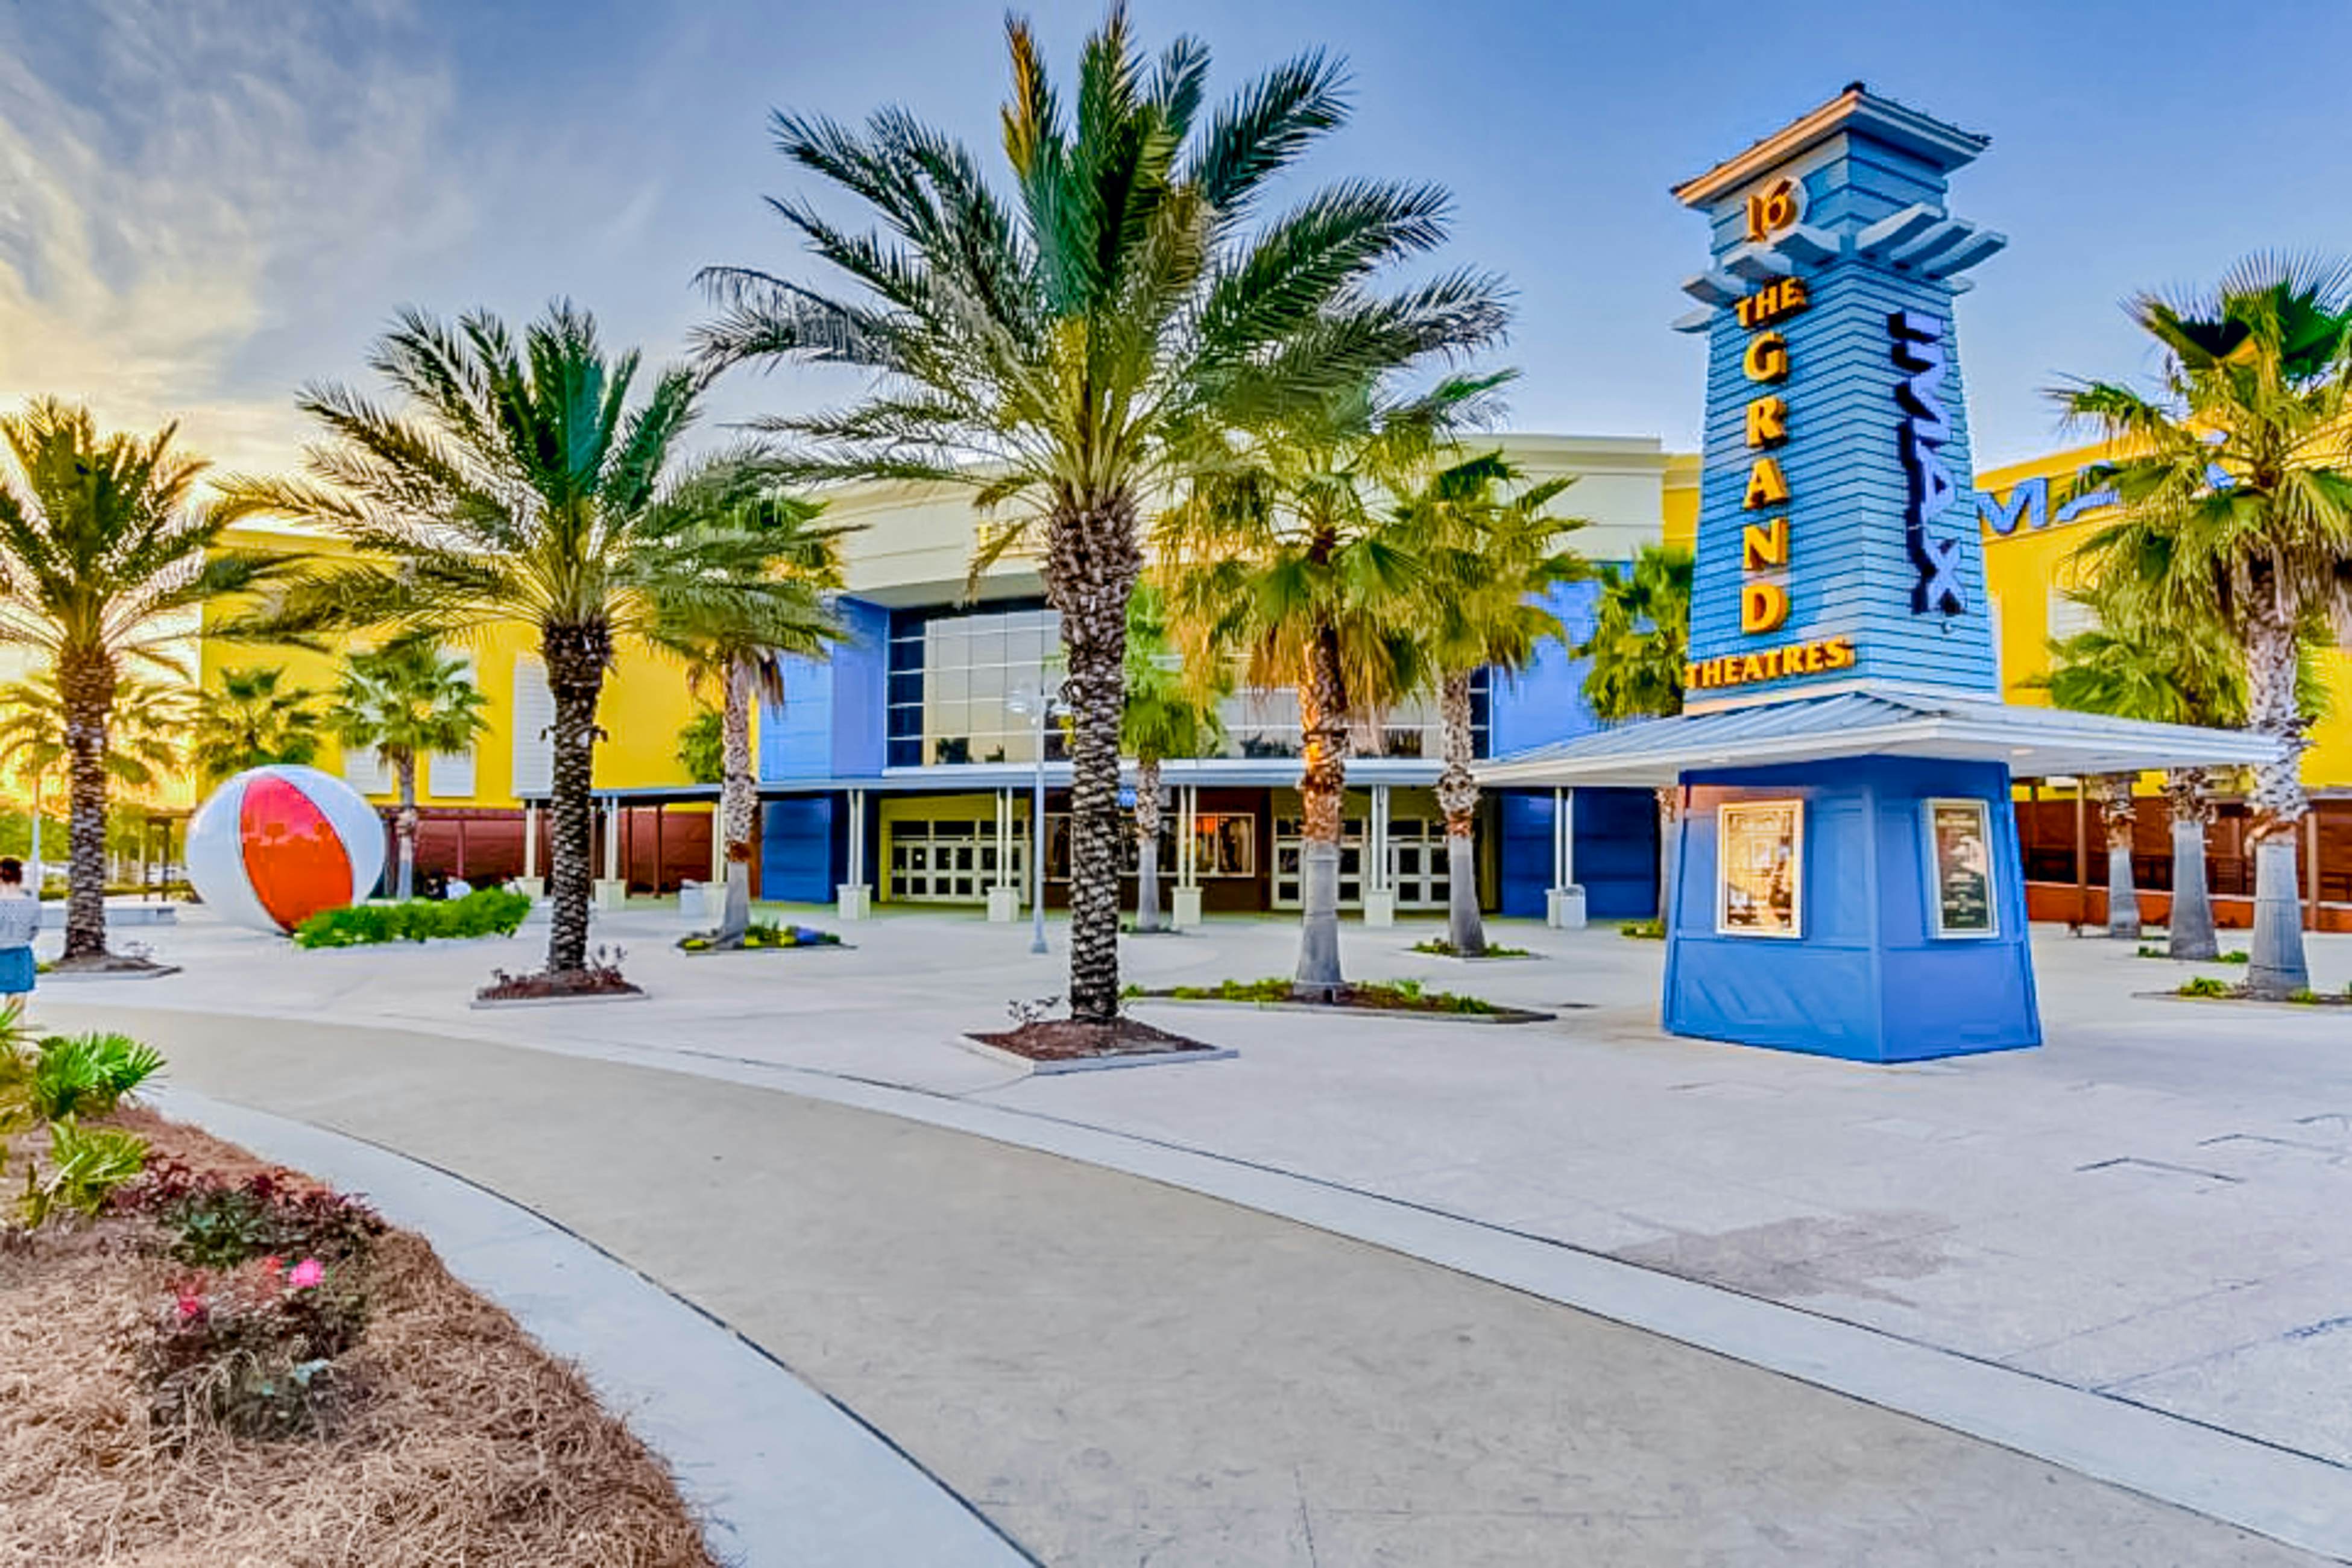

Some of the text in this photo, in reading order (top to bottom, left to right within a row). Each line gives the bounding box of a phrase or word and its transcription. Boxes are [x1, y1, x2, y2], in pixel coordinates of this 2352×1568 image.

[1747, 179, 1797, 242] 16
[1735, 276, 1808, 327] THE
[1742, 331, 1791, 634] GRAND
[1888, 311, 1967, 614] IMAX
[1686, 635, 1855, 689] THEATRES
